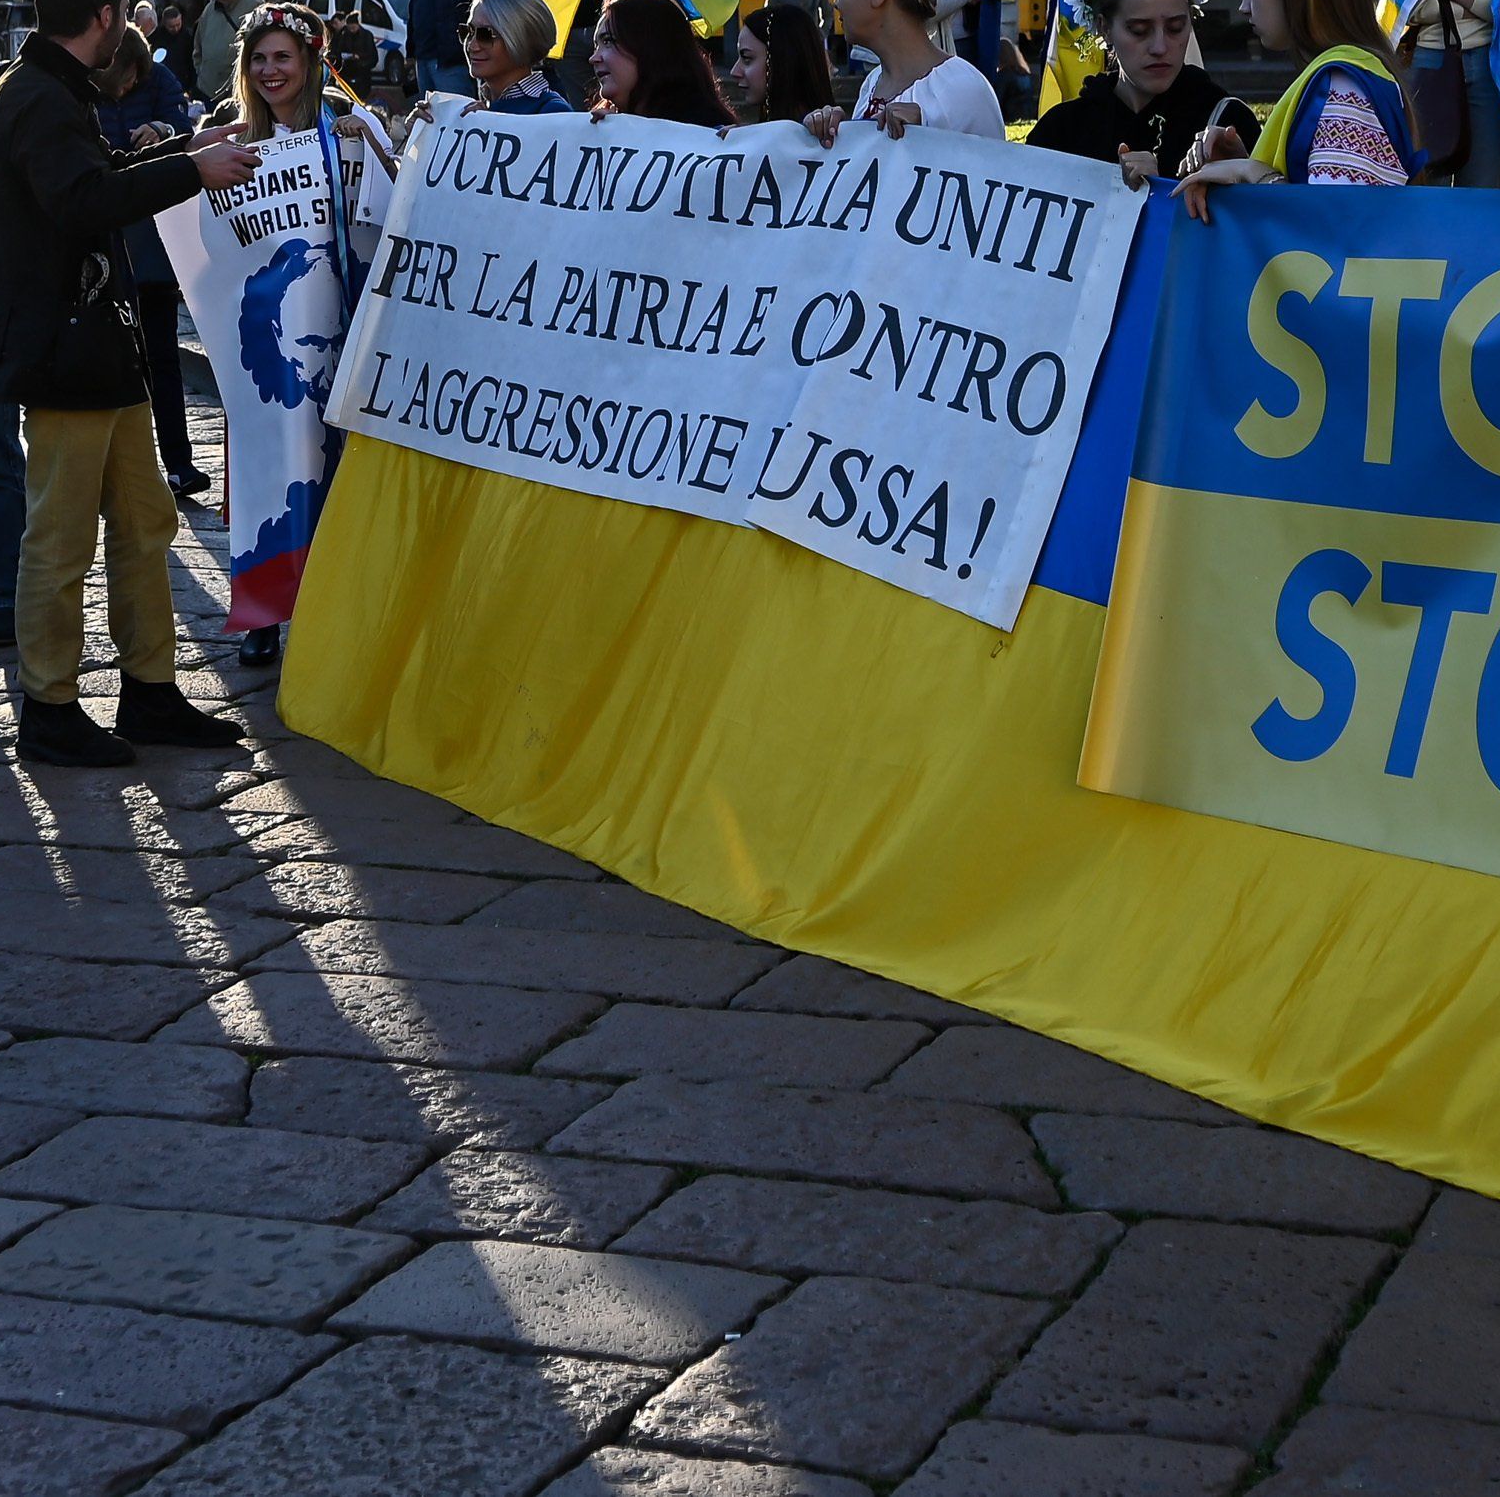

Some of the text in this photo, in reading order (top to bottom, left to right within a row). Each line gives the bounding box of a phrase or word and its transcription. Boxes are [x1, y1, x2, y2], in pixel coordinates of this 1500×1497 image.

[625, 149, 881, 231] D'ITALIA
[895, 164, 1097, 283] UNITI
[370, 233, 459, 311] PER
[466, 251, 538, 328] LA
[543, 265, 732, 355] PATRIA
[730, 285, 778, 358] E
[359, 350, 749, 495] L'AGGRESSIONE
